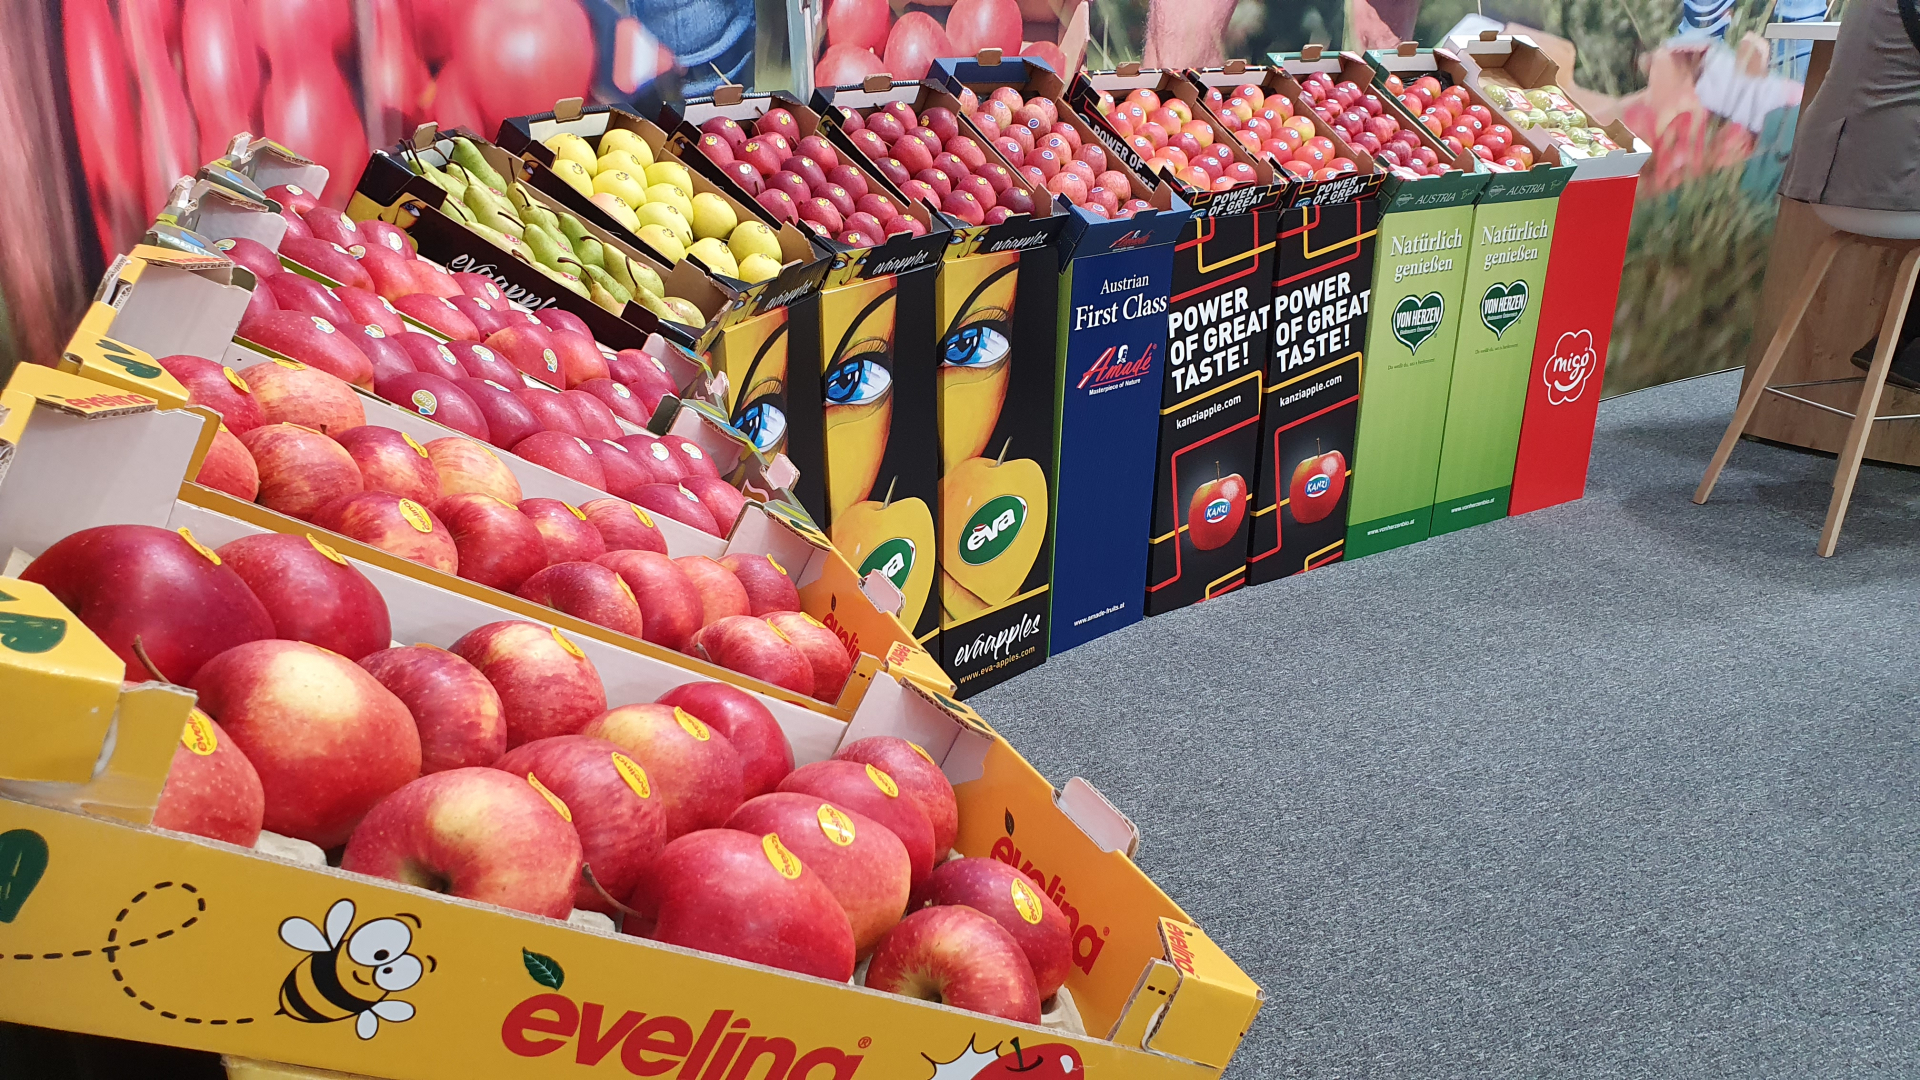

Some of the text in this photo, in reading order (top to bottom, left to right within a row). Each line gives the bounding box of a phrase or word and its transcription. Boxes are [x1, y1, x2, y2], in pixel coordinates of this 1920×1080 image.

[1093, 124, 1145, 171] POWER OF
[1212, 186, 1256, 206] POWER
[1313, 192, 1329, 205] OF
[1330, 182, 1367, 200] GREAT
[1317, 176, 1359, 196] POWER
[1415, 192, 1456, 205] AUSTRIA
[1506, 183, 1546, 196] AUSTRIA
[1208, 203, 1225, 216] OF
[1226, 193, 1266, 212] GREAT
[1390, 228, 1463, 256] Natürlich
[1481, 219, 1549, 246] Natürlich
[1394, 255, 1453, 282] genießen
[1484, 245, 1538, 271] genießen
[452, 254, 557, 311] evaappl
[1100, 274, 1149, 295] Austrian
[1275, 272, 1351, 321] POWER
[1074, 293, 1167, 331] First Class
[1168, 286, 1249, 340] POWER
[1276, 289, 1371, 347] OF GREAT
[1396, 306, 1441, 329] VON HERZEN
[1484, 294, 1525, 314] VON HERZEN
[1170, 304, 1271, 366] OF GREAT
[1277, 324, 1350, 373] TASTE!
[1076, 343, 1153, 390] Amadé
[1172, 341, 1249, 394] TASTE!
[1088, 384, 1119, 396] Masterpiece
[1125, 378, 1141, 387] Nature
[1279, 374, 1342, 407] kanziapple.com
[1176, 395, 1242, 430] kanziapple.com
[954, 613, 1041, 667] evaapples
[960, 645, 1036, 684] www.eva-apples.com
[1165, 921, 1195, 976] evelina
